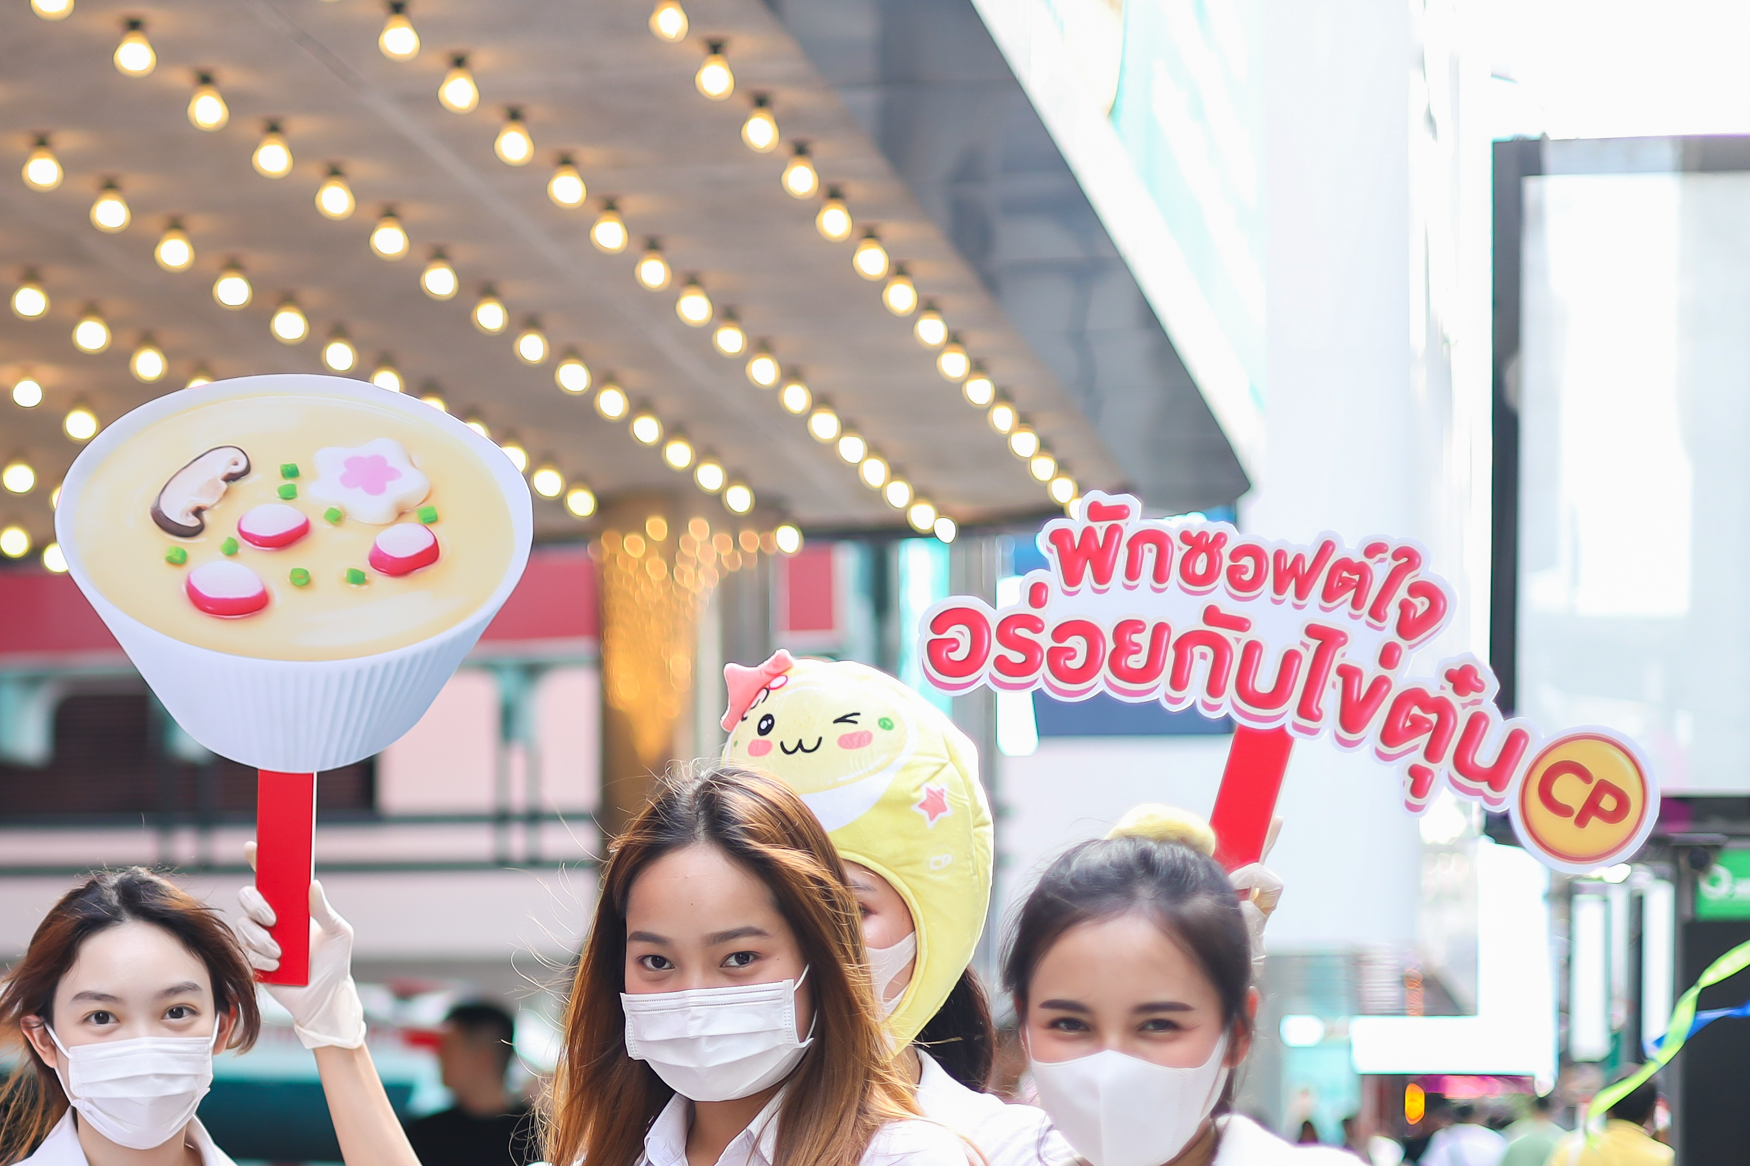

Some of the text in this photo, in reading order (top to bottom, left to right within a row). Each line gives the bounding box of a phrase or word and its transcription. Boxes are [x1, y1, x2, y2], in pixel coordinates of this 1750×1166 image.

[1048, 501, 1447, 645] พักซอฟต์ใจ
[924, 582, 1530, 811] อร่อยกับไข่ตุ๋น
[1537, 759, 1632, 829] CP
